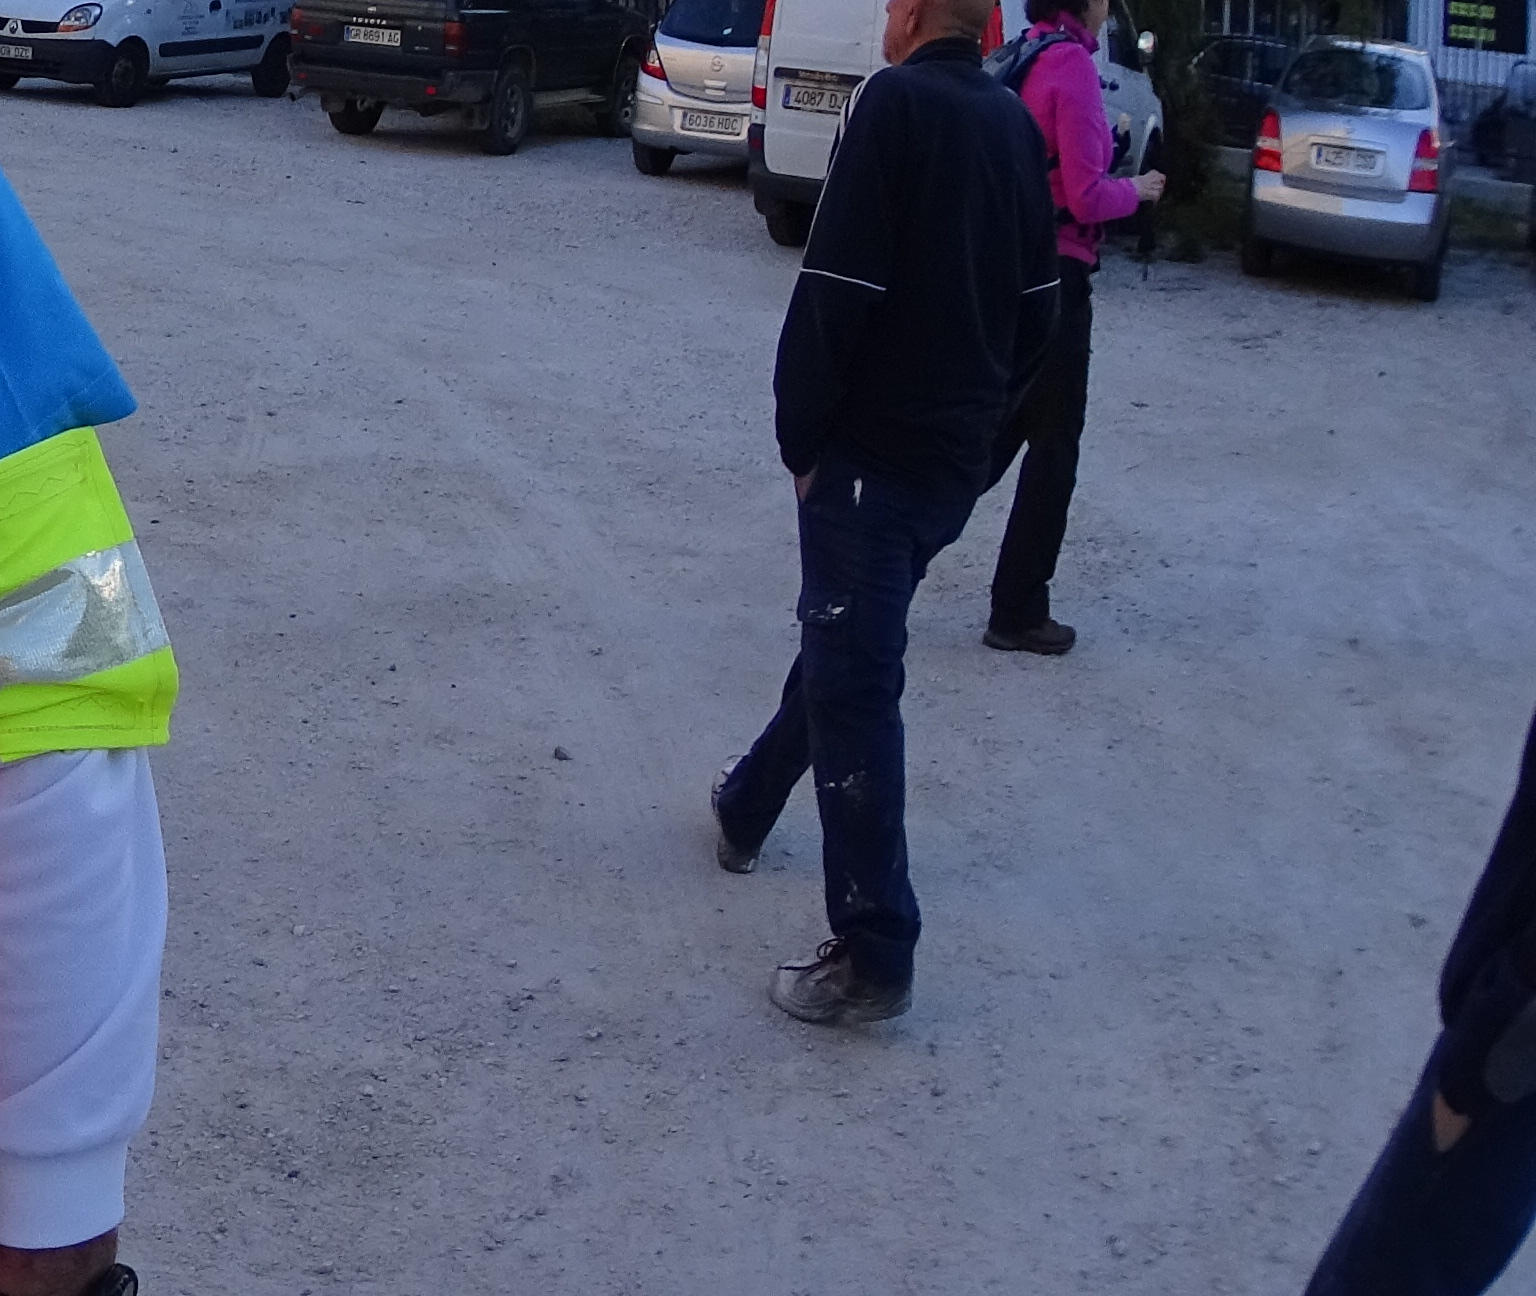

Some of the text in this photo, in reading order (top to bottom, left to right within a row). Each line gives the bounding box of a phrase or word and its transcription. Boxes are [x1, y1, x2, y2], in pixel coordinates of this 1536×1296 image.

[794, 90, 825, 107] 4087
[688, 114, 738, 131] 6036 HDC
